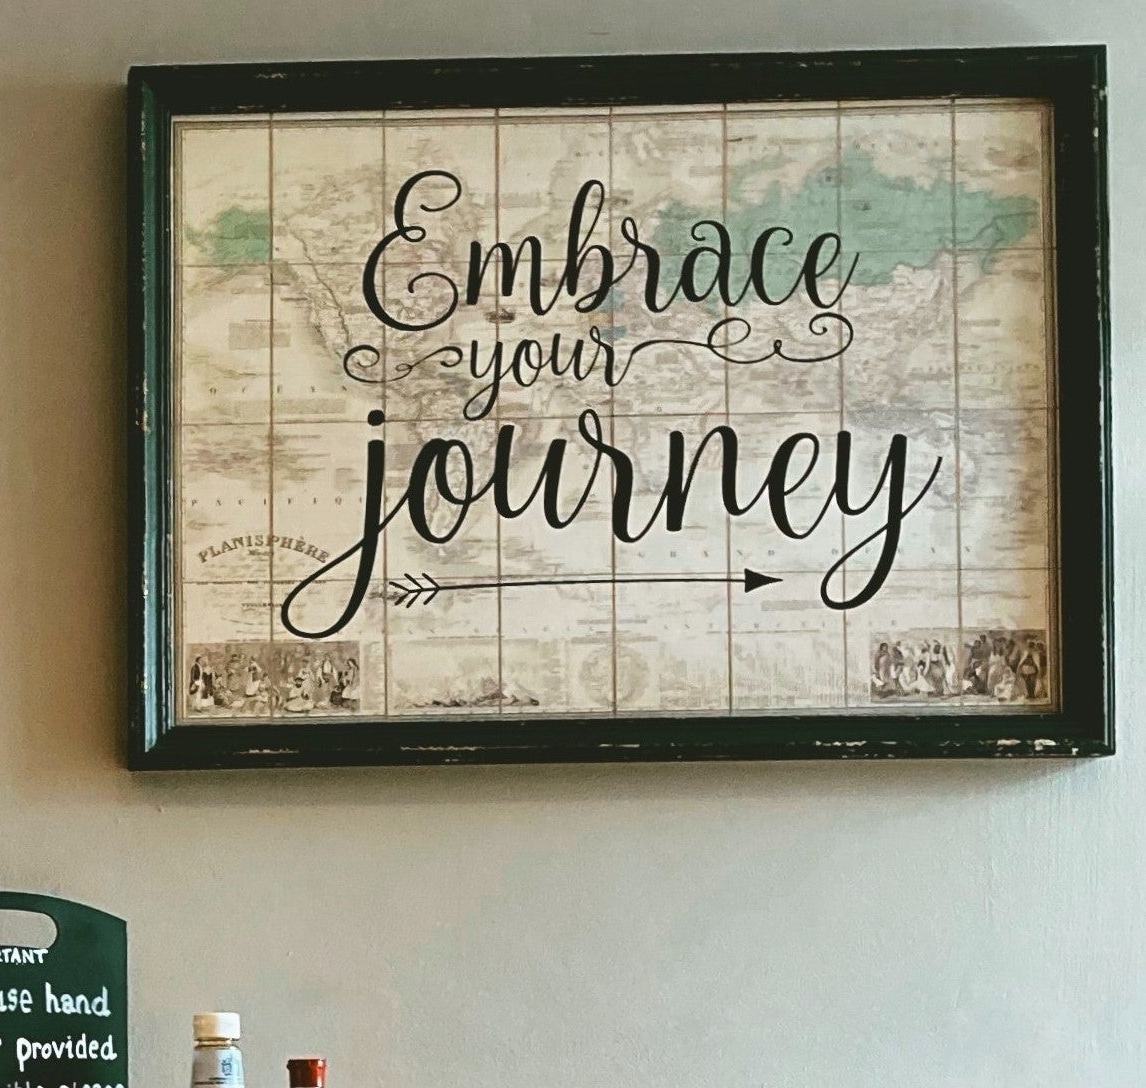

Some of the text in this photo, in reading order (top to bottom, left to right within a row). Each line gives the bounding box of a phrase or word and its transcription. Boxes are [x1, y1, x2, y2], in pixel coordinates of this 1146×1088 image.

[362, 170, 859, 331] Embrace
[463, 325, 637, 421] your
[281, 409, 944, 639] journey
[45, 981, 112, 1017] hand
[16, 1033, 118, 1072] provided
